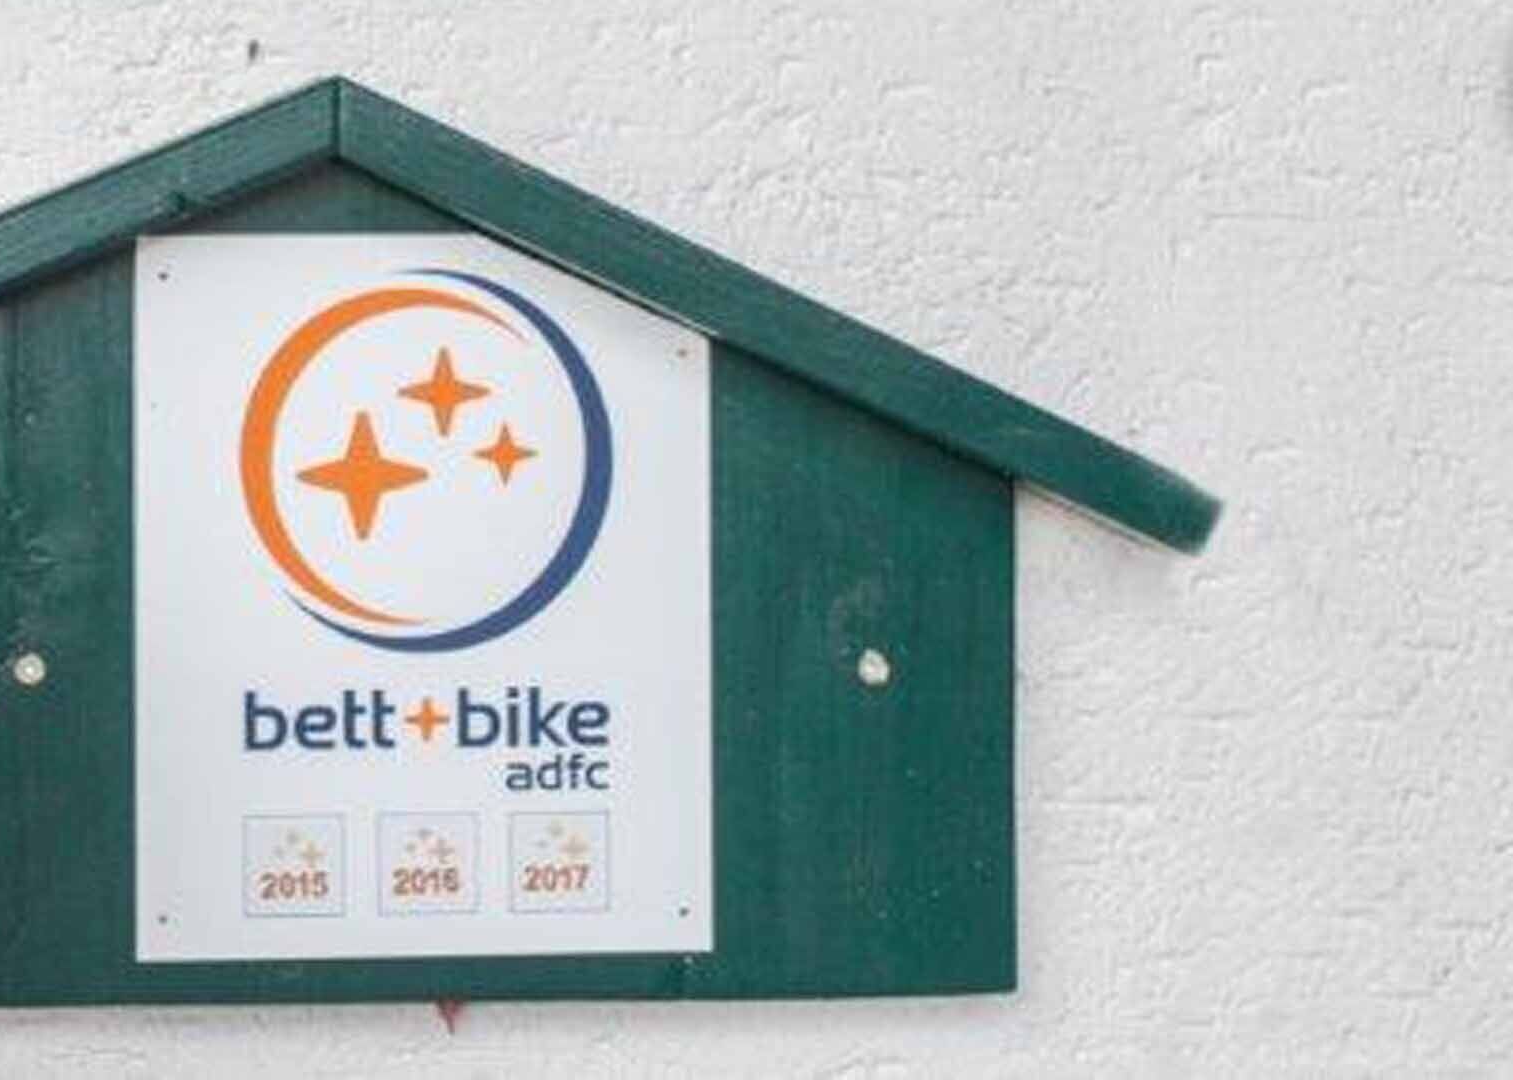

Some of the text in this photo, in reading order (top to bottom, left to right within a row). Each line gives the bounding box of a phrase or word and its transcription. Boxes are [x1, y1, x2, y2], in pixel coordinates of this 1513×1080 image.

[505, 754, 610, 791] adfc
[259, 872, 329, 899] 2015
[393, 869, 460, 896] 2016
[523, 865, 591, 892] 2017
